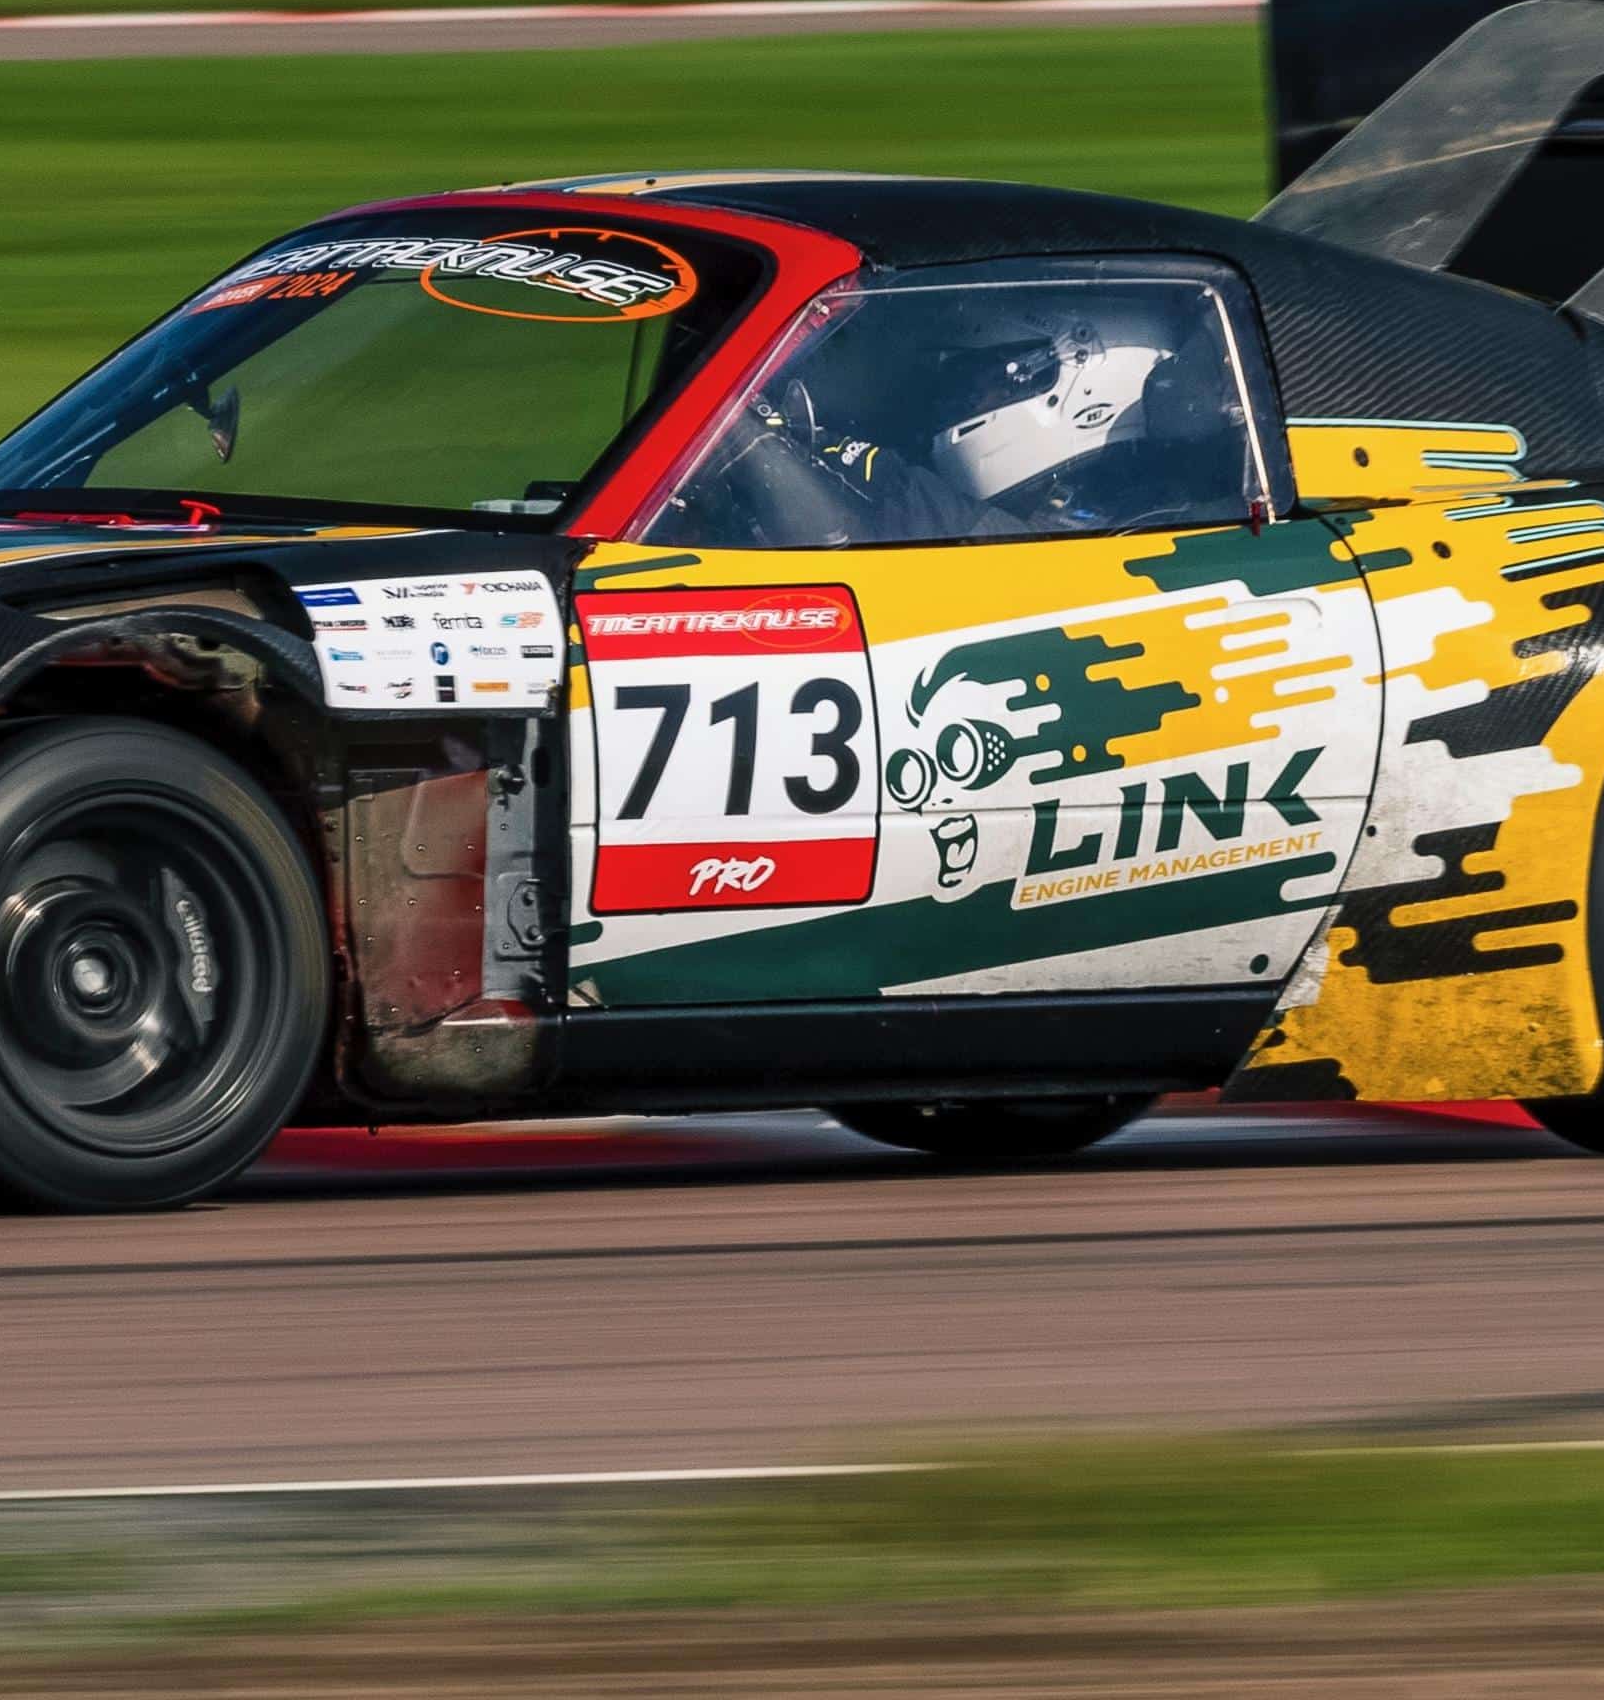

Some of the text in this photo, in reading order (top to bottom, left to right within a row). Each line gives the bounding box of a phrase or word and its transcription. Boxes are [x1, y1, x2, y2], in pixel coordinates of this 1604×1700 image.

[268, 271, 357, 300] 2024
[614, 677, 863, 820] 713
[1024, 745, 1327, 876] LINK
[689, 856, 776, 896] PRO
[1018, 831, 1323, 904] ENGINE MANAGEMENT
